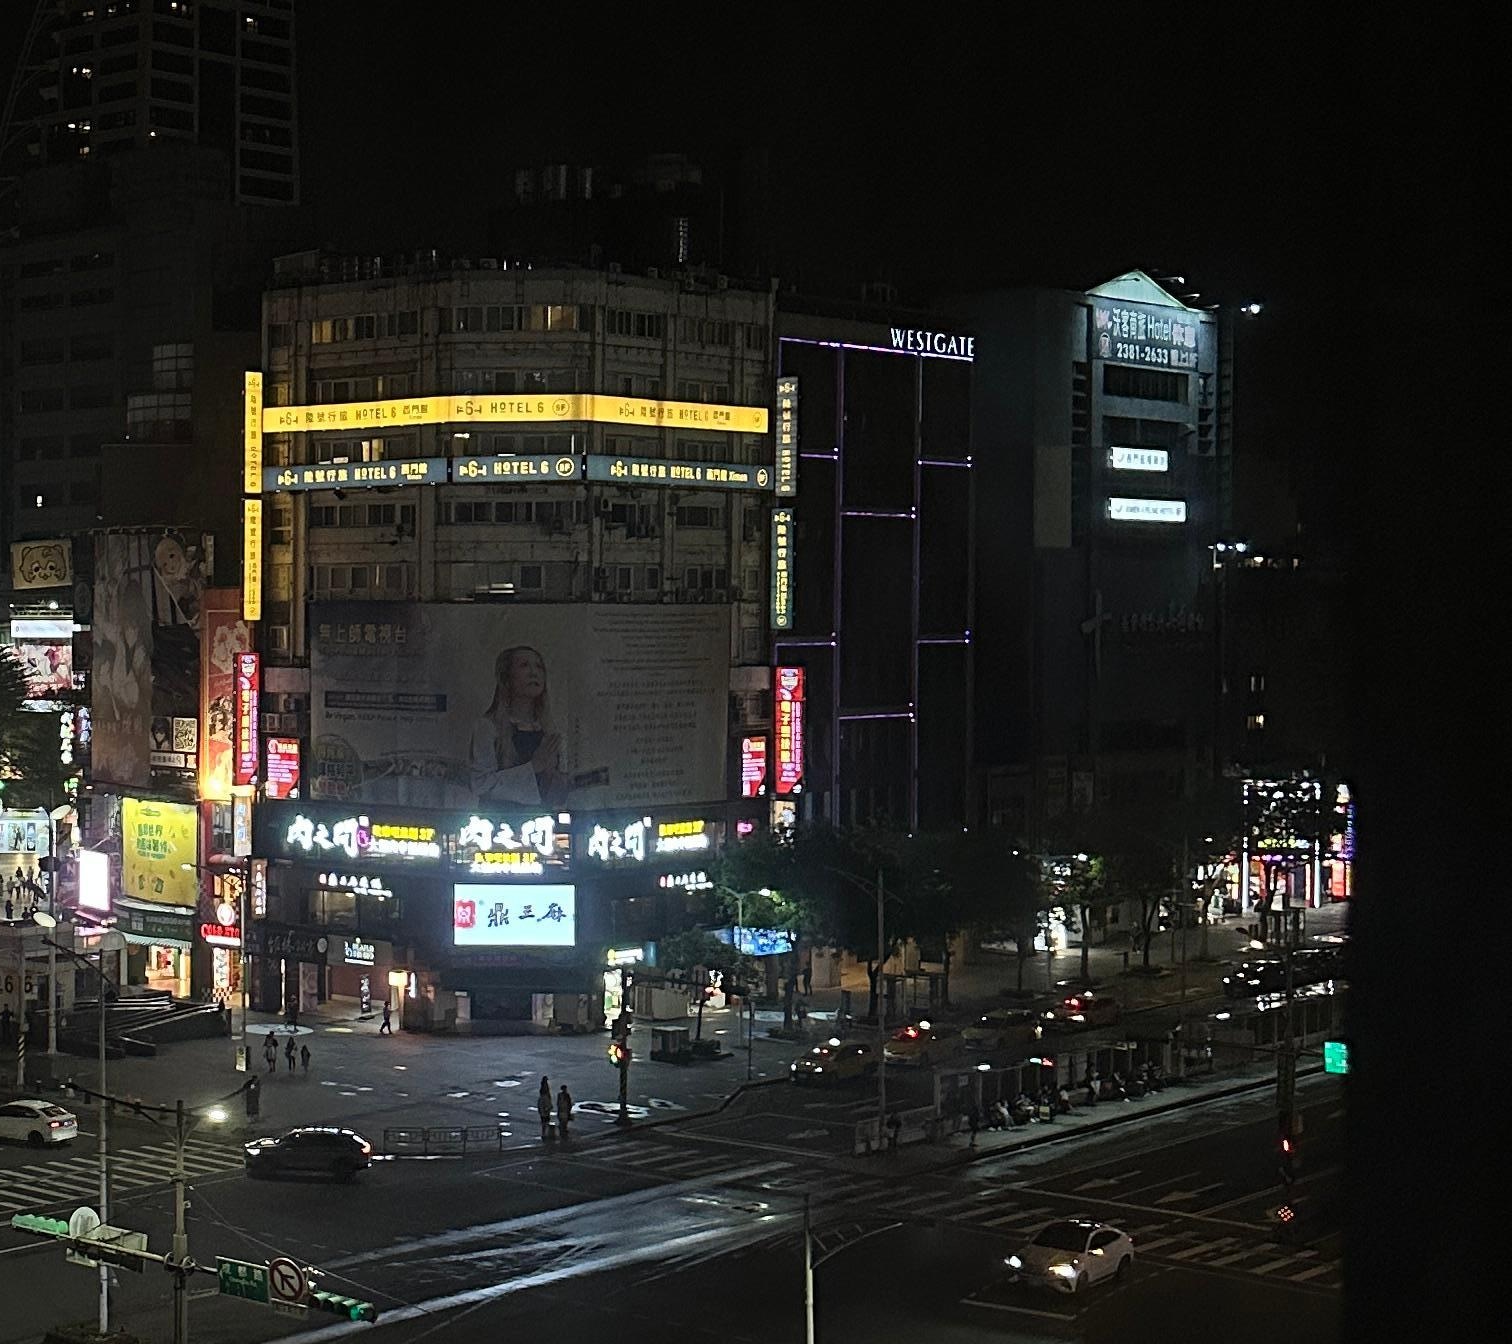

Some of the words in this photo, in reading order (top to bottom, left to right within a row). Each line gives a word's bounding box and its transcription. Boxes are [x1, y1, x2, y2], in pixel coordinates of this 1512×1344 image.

[890, 328, 975, 357] WESTGATE
[491, 402, 532, 413] HOTEL
[538, 402, 544, 413] 6
[356, 409, 387, 421] HOTEL
[354, 467, 387, 481] HOTEL
[494, 461, 537, 474] HOTEL
[540, 460, 549, 474] 6
